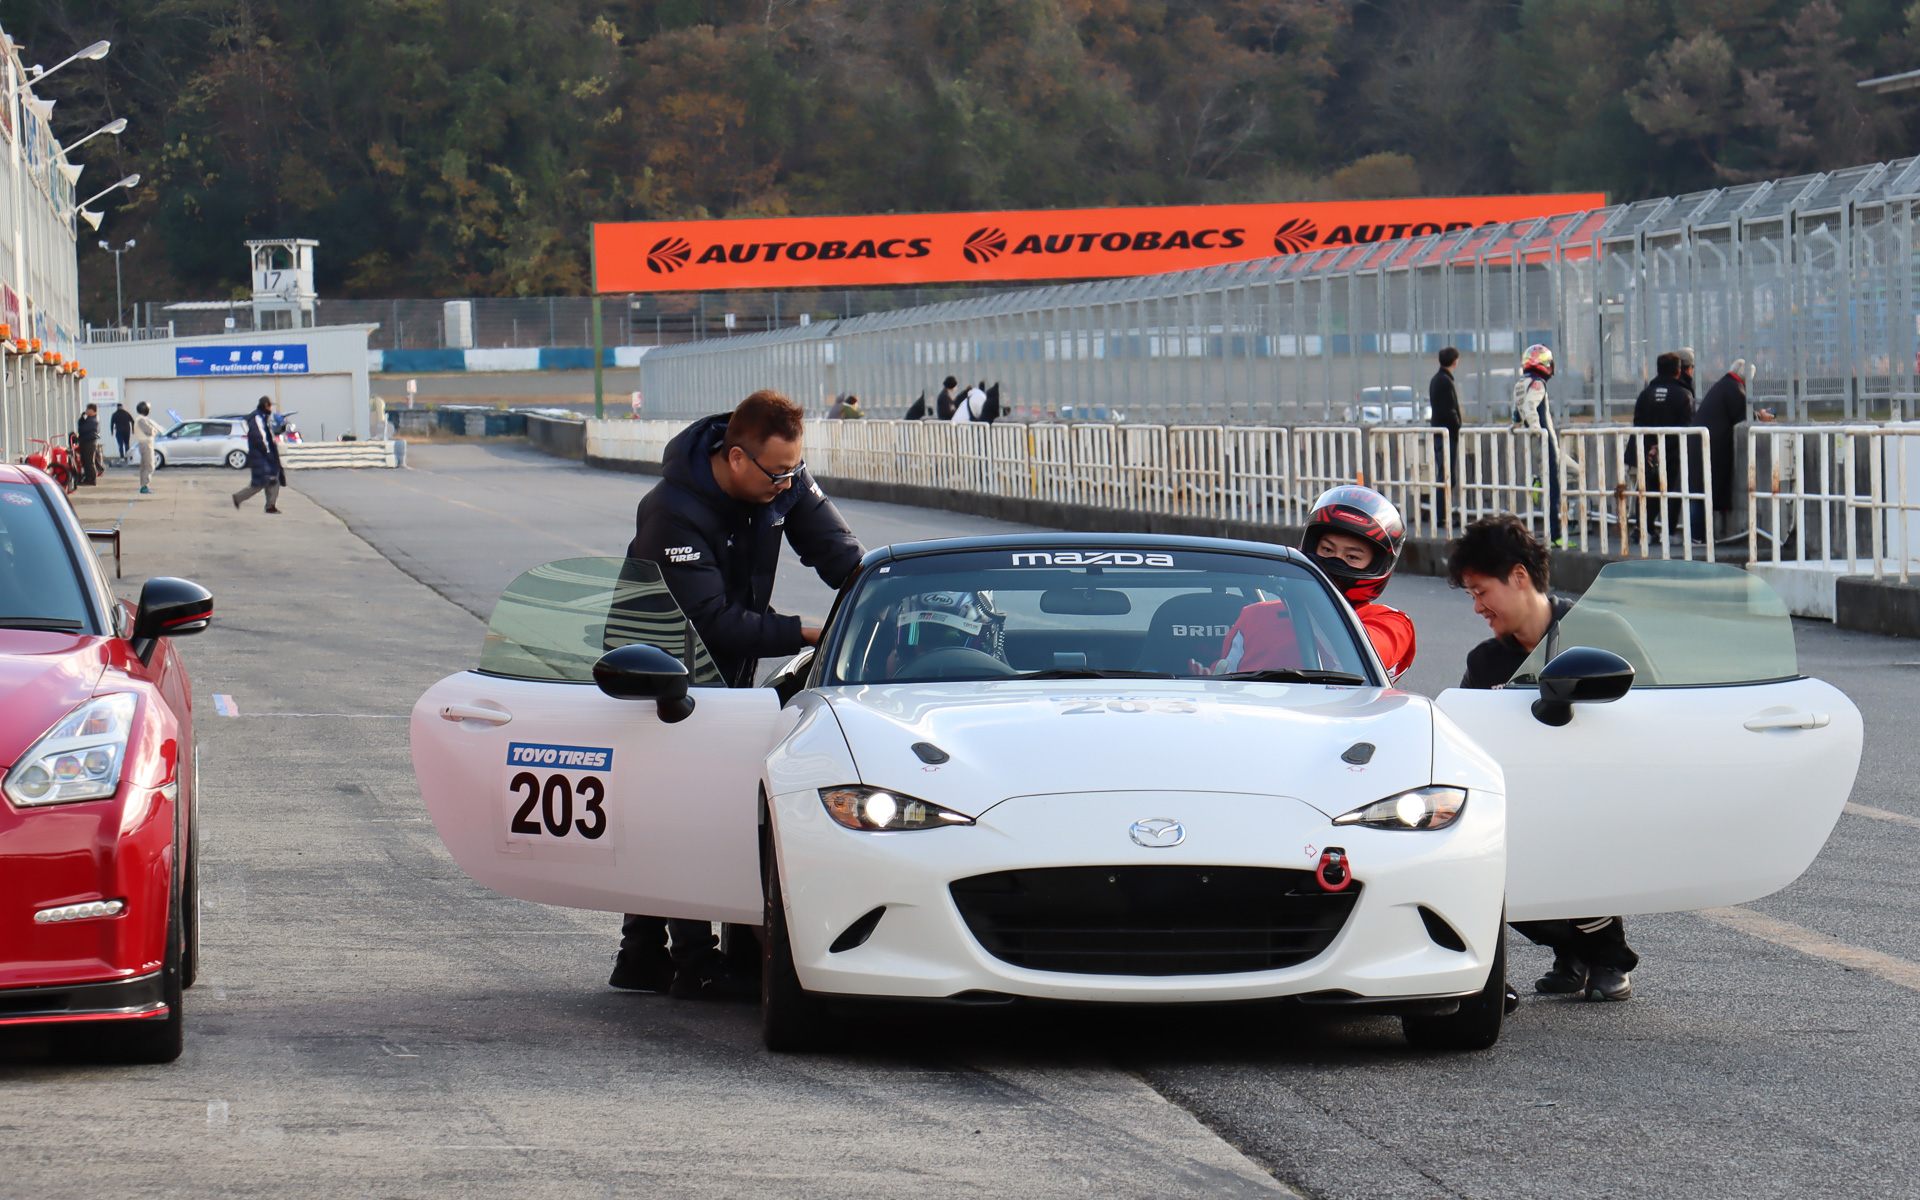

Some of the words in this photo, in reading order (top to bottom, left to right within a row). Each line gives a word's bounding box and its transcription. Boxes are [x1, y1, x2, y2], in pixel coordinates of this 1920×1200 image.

[695, 238, 931, 264] AUTOBACS
[1010, 228, 1245, 254] AUTOBACS
[264, 271, 281, 290] 17
[210, 363, 270, 372] Scrutineering
[272, 362, 305, 371] Garage
[664, 546, 693, 555] TOYO
[670, 552, 701, 563] TIRES
[1012, 552, 1174, 567] mazda
[1172, 624, 1235, 637] BRID
[1059, 700, 1198, 715] 203
[513, 747, 557, 764] TOYO
[558, 750, 607, 767] TIRES
[509, 771, 607, 840] 203
